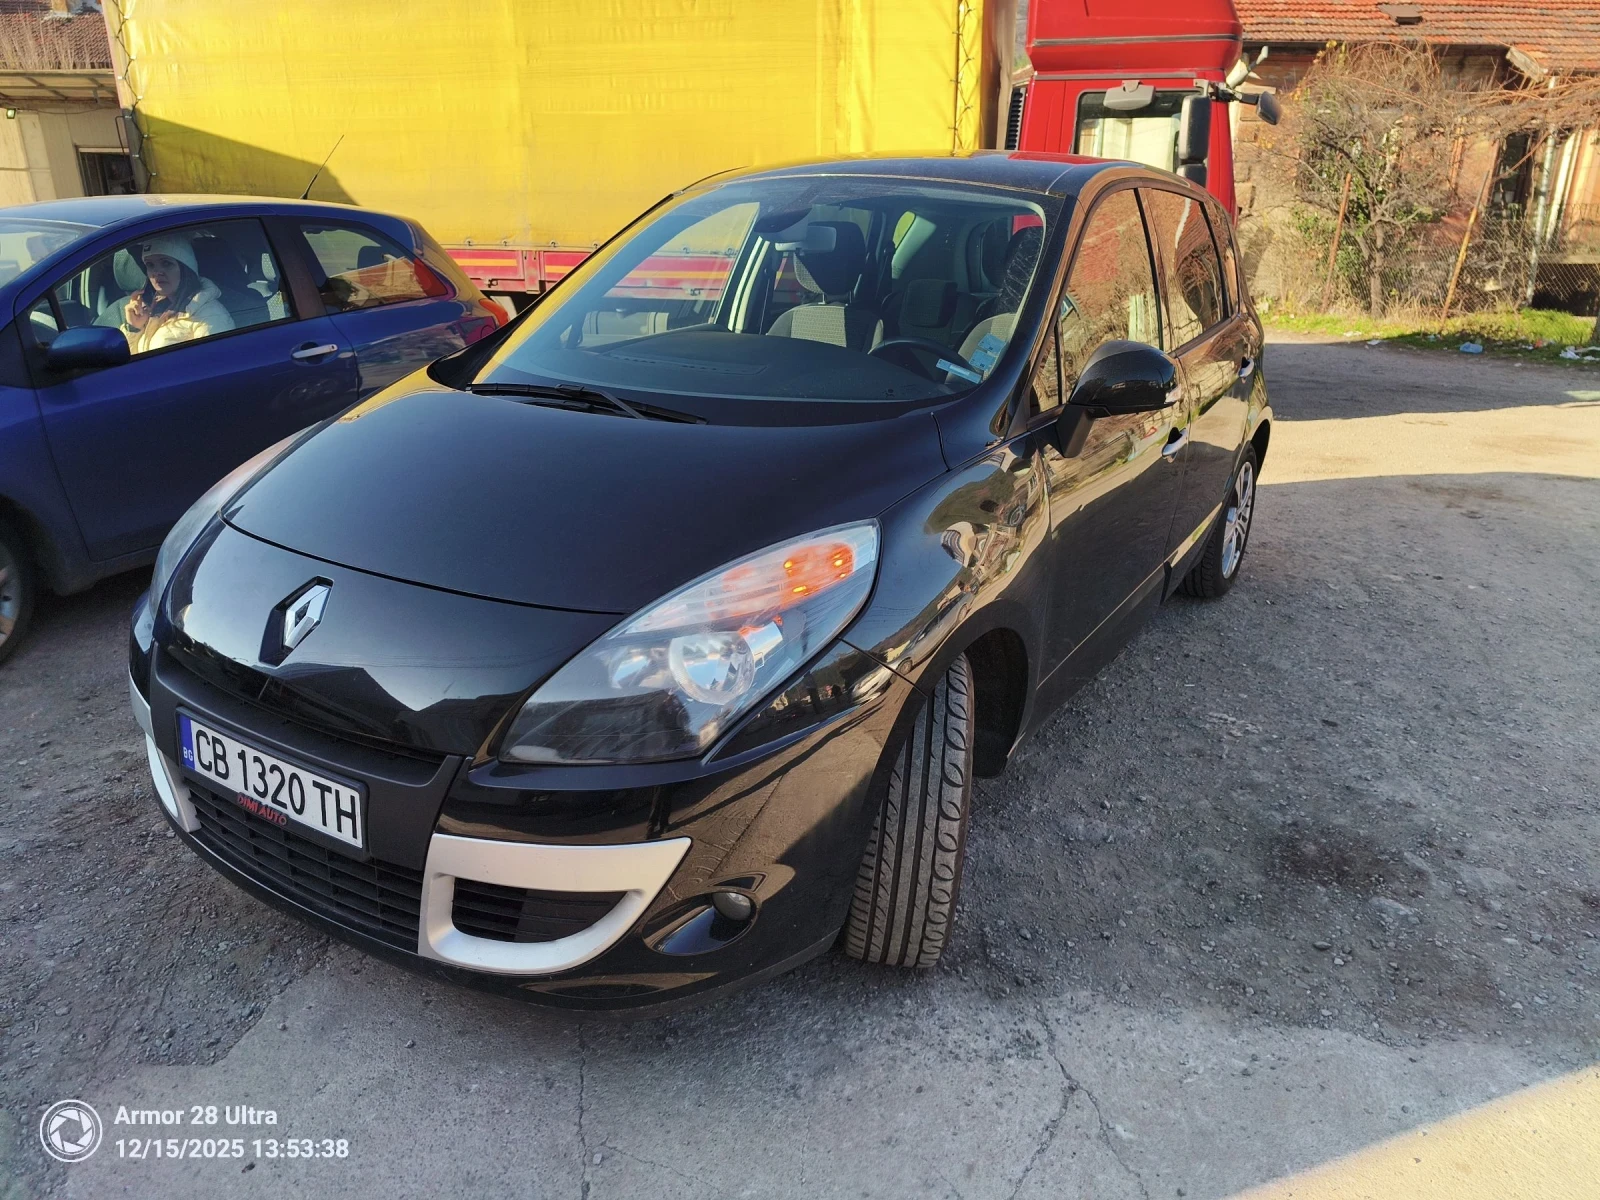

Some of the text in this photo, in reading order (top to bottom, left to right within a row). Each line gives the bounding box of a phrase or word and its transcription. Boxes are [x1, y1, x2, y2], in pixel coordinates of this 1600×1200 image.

[183, 746, 194, 762] BG
[195, 729, 358, 840] CB 1320 TH
[259, 806, 288, 826] AUTO
